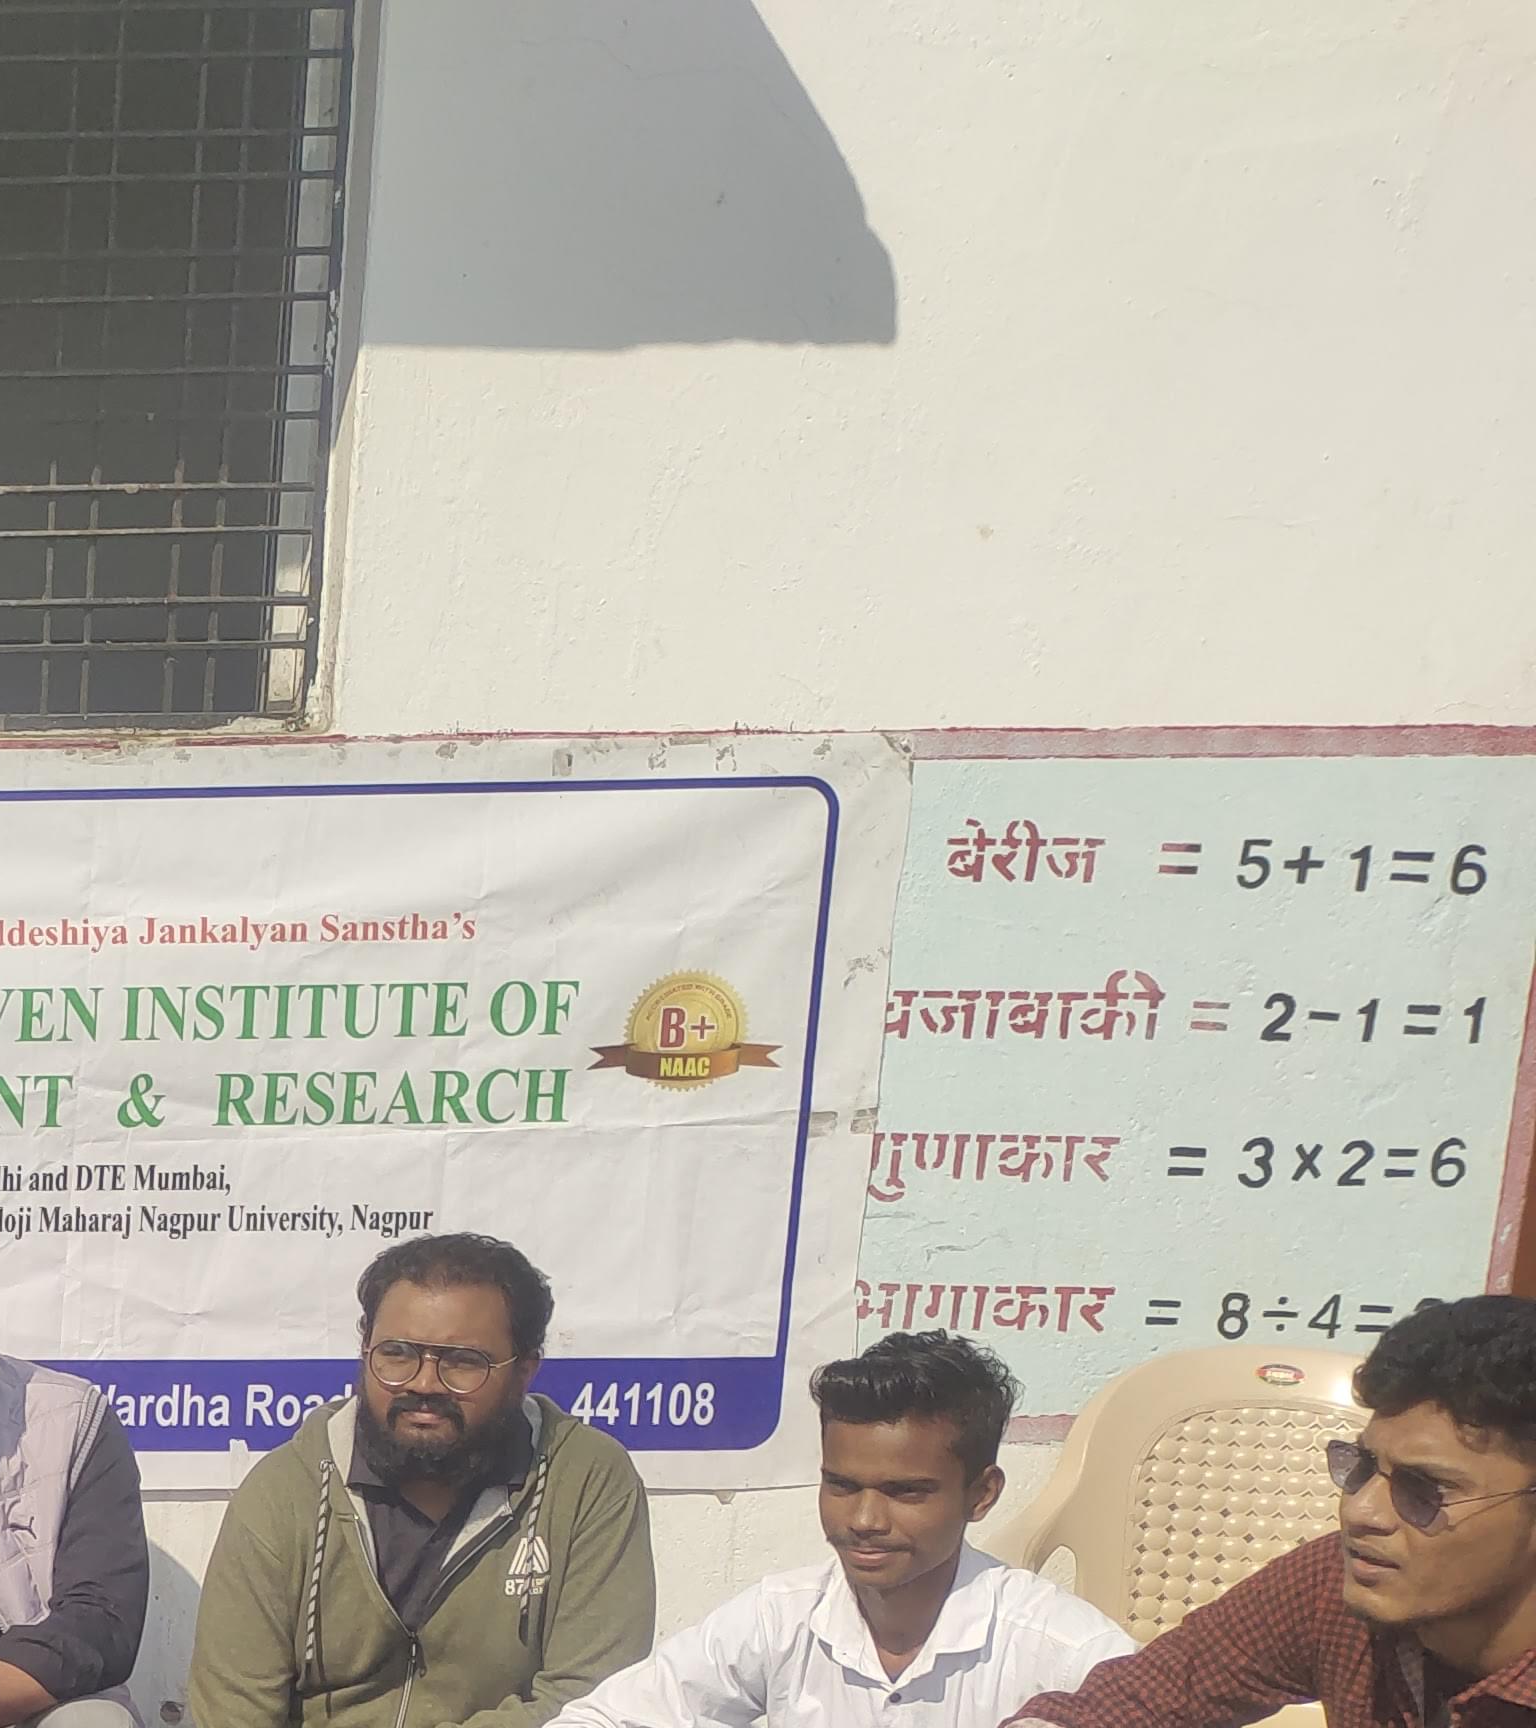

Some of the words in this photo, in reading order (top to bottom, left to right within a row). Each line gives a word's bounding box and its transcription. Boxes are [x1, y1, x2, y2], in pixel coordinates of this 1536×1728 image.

[947, 820, 1105, 884] बेरीज
[139, 916, 308, 950] Jankalyan
[119, 981, 470, 1041] INSTITUTE
[489, 980, 580, 1038] OF
[660, 1008, 715, 1048] B+
[660, 1057, 710, 1077] NAAC
[117, 1072, 166, 1129] &
[212, 1068, 570, 1127] RESEARCH
[28, 1165, 68, 1192] and
[75, 1165, 125, 1191] DTE
[133, 1164, 231, 1196] Mumbai,
[868, 1133, 1121, 1202] गुणाकार
[38, 1206, 132, 1239] Maharaj
[138, 1206, 222, 1239] Nagpur
[227, 1204, 343, 1237] University,
[349, 1204, 434, 1239] Nagpur
[856, 1279, 1116, 1333] भागाकार
[570, 1382, 715, 1426] 441108
